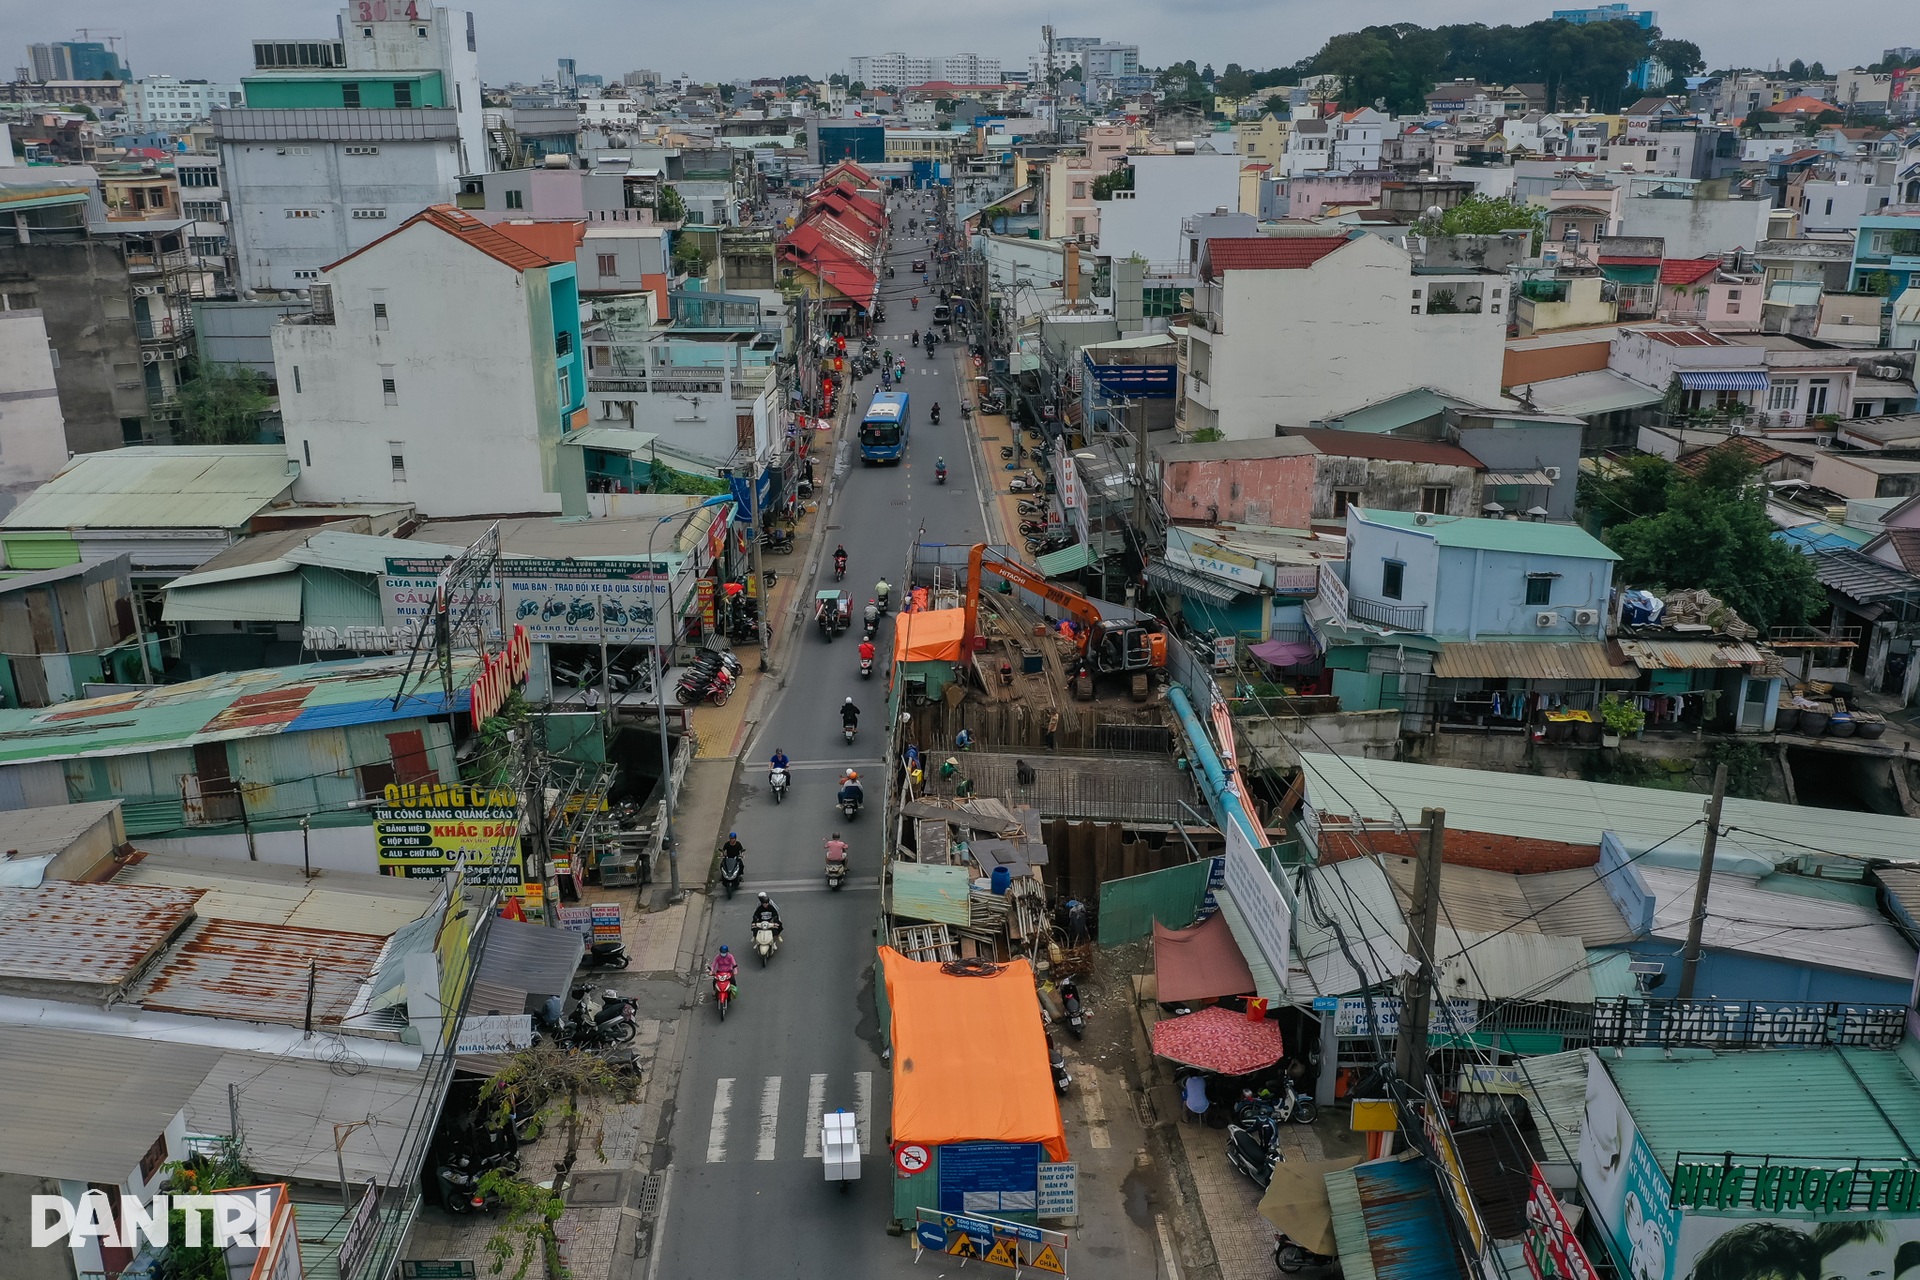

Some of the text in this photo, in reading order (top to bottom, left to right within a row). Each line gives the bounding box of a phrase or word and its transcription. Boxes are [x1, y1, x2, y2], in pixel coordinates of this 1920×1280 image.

[1198, 558, 1225, 572] TÀI
[386, 579, 410, 588] CỬA
[999, 568, 1026, 585] HITACHI
[512, 582, 531, 591] MUA
[555, 583, 574, 592] TRAO
[576, 580, 589, 592] ĐỔI
[590, 583, 600, 592] XE
[615, 584, 630, 593] QUA
[394, 589, 431, 604] CẦU
[397, 607, 417, 615] MUA
[470, 651, 511, 733] QUẢNG
[375, 808, 513, 820] THI CÔNG BẢNG QUẢNG CÁO
[386, 823, 409, 832] BẢNG
[409, 825, 426, 833] HIỆU
[433, 822, 478, 837] KHẮC
[387, 835, 420, 845] HỘP ĐÈN
[388, 849, 403, 857] ALU
[409, 848, 425, 857] CHỮ
[426, 847, 440, 857] NỔI
[1635, 1141, 1675, 1223] NHA KHOA
[1671, 1161, 1746, 1210] NHA
[1753, 1164, 1853, 1214] KHOA
[1629, 1158, 1673, 1247] KỸ THUẬT CAO
